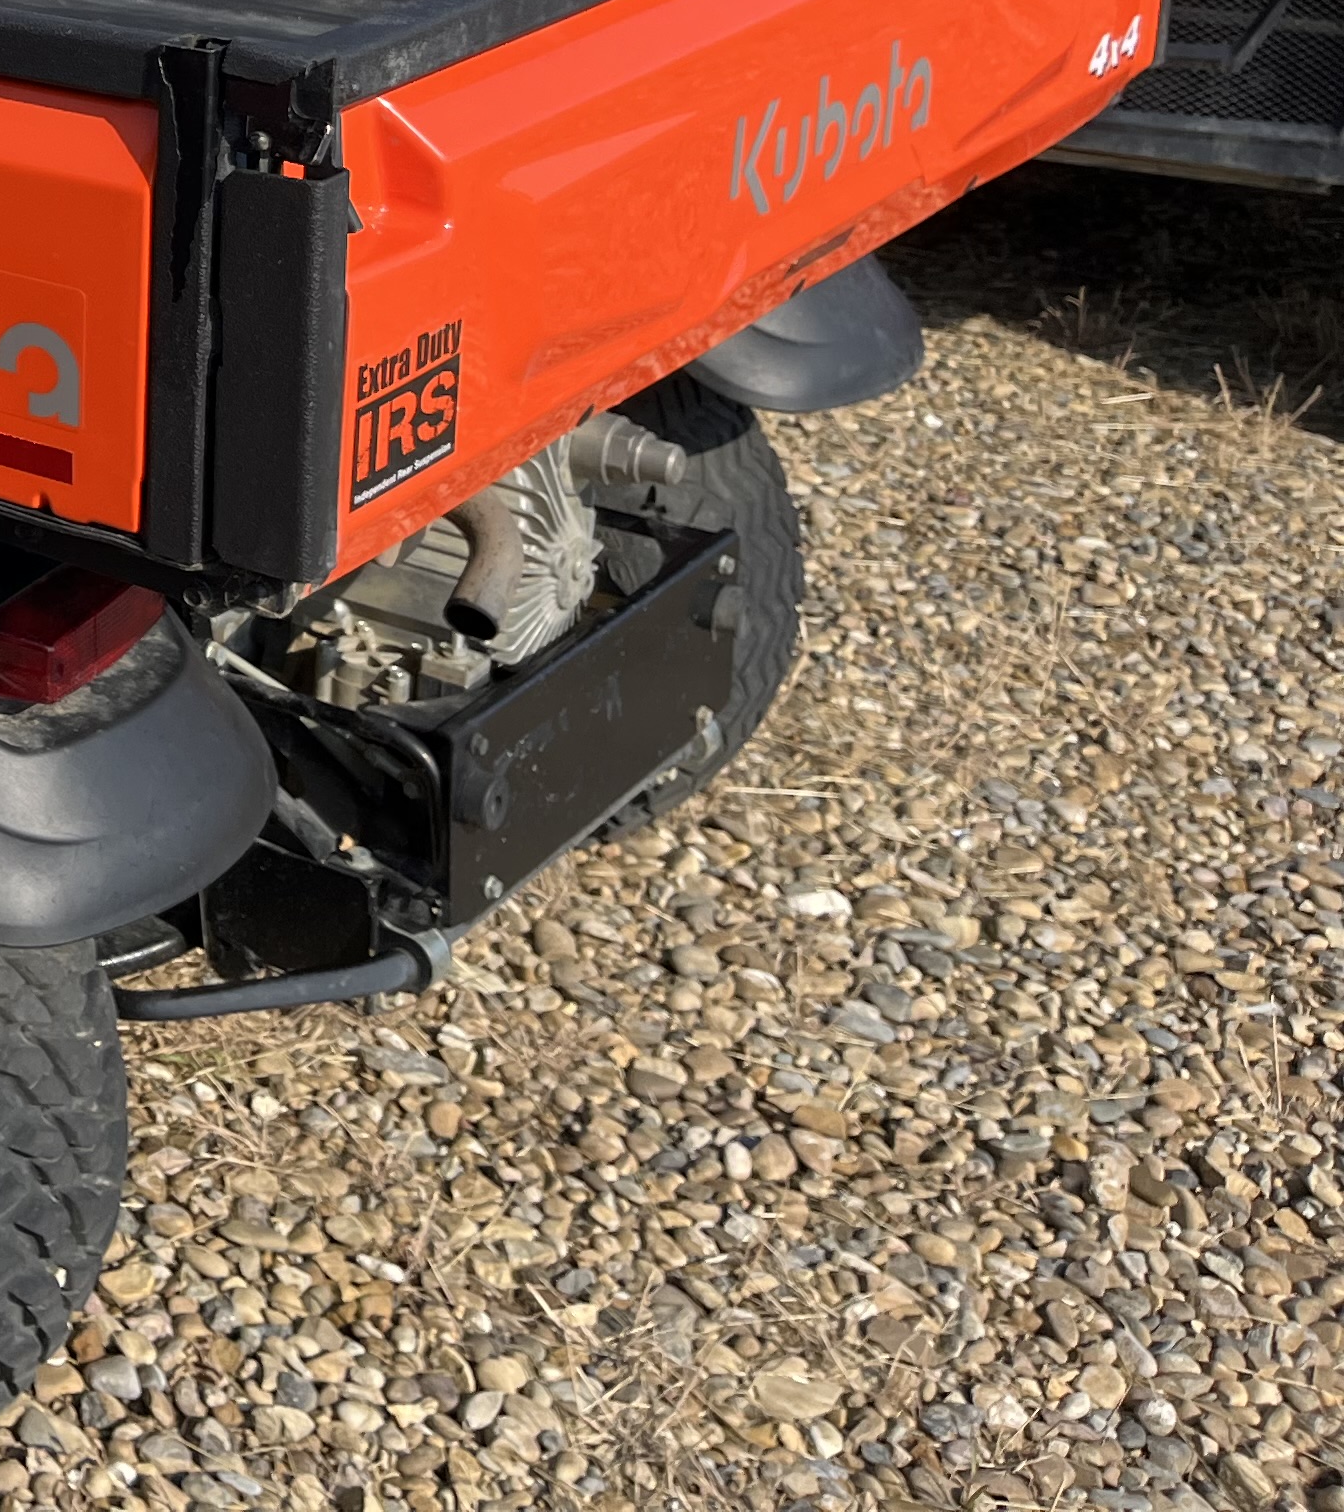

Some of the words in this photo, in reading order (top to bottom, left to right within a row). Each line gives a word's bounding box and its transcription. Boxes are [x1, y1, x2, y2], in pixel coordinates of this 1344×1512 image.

[1087, 14, 1142, 78] 4x4
[729, 39, 932, 215] Kubota
[357, 347, 411, 403] Extra
[416, 318, 463, 372] Duty
[356, 370, 456, 482] IRS
[397, 464, 414, 480] Rear
[413, 442, 452, 470] Suspension
